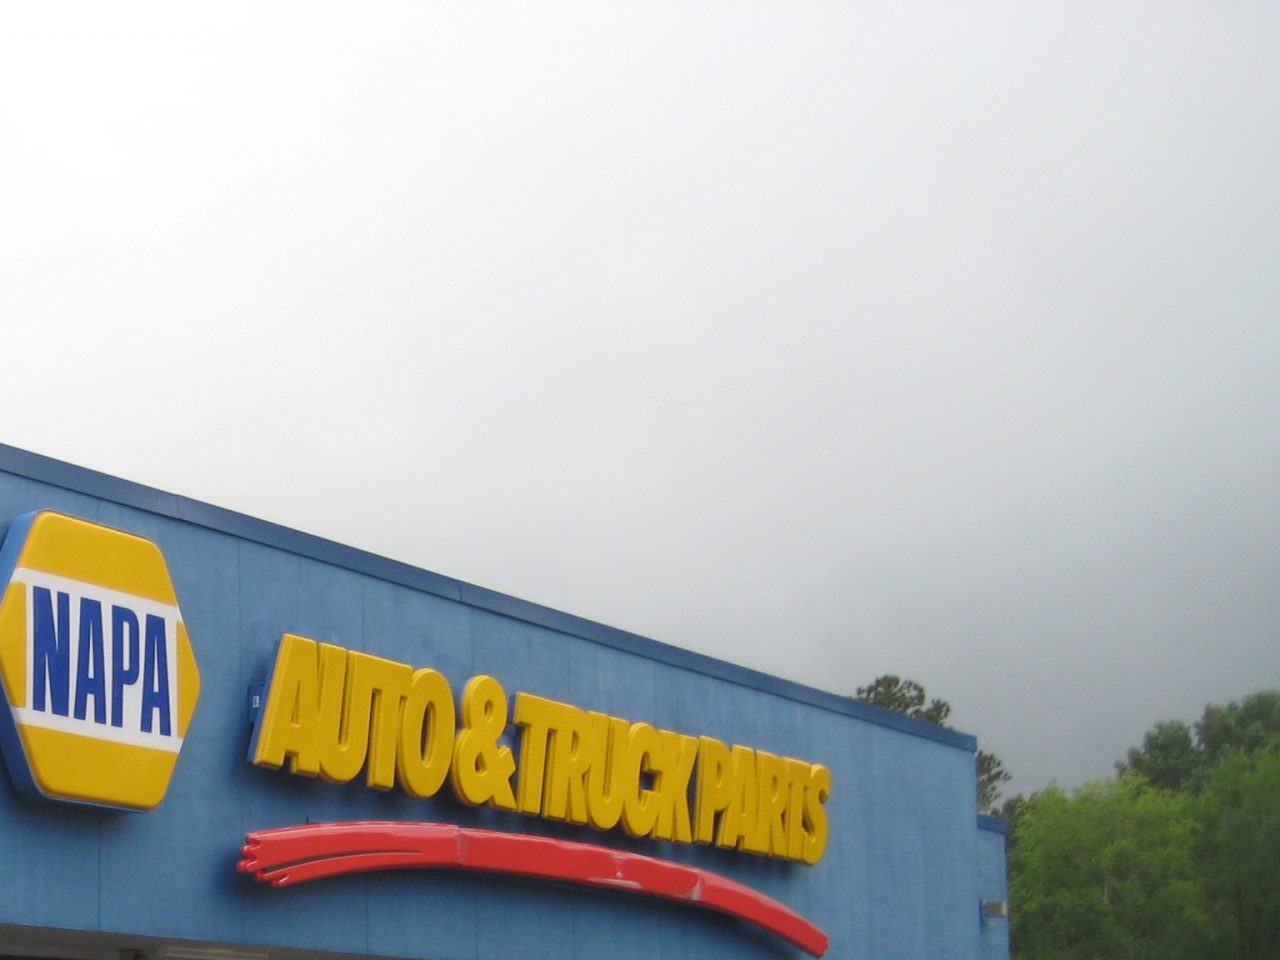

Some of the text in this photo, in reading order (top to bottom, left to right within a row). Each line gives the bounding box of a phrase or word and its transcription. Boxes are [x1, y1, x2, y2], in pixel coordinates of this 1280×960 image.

[33, 585, 171, 736] NAPA
[253, 633, 832, 866] AUTO & TRUCK PARTS
